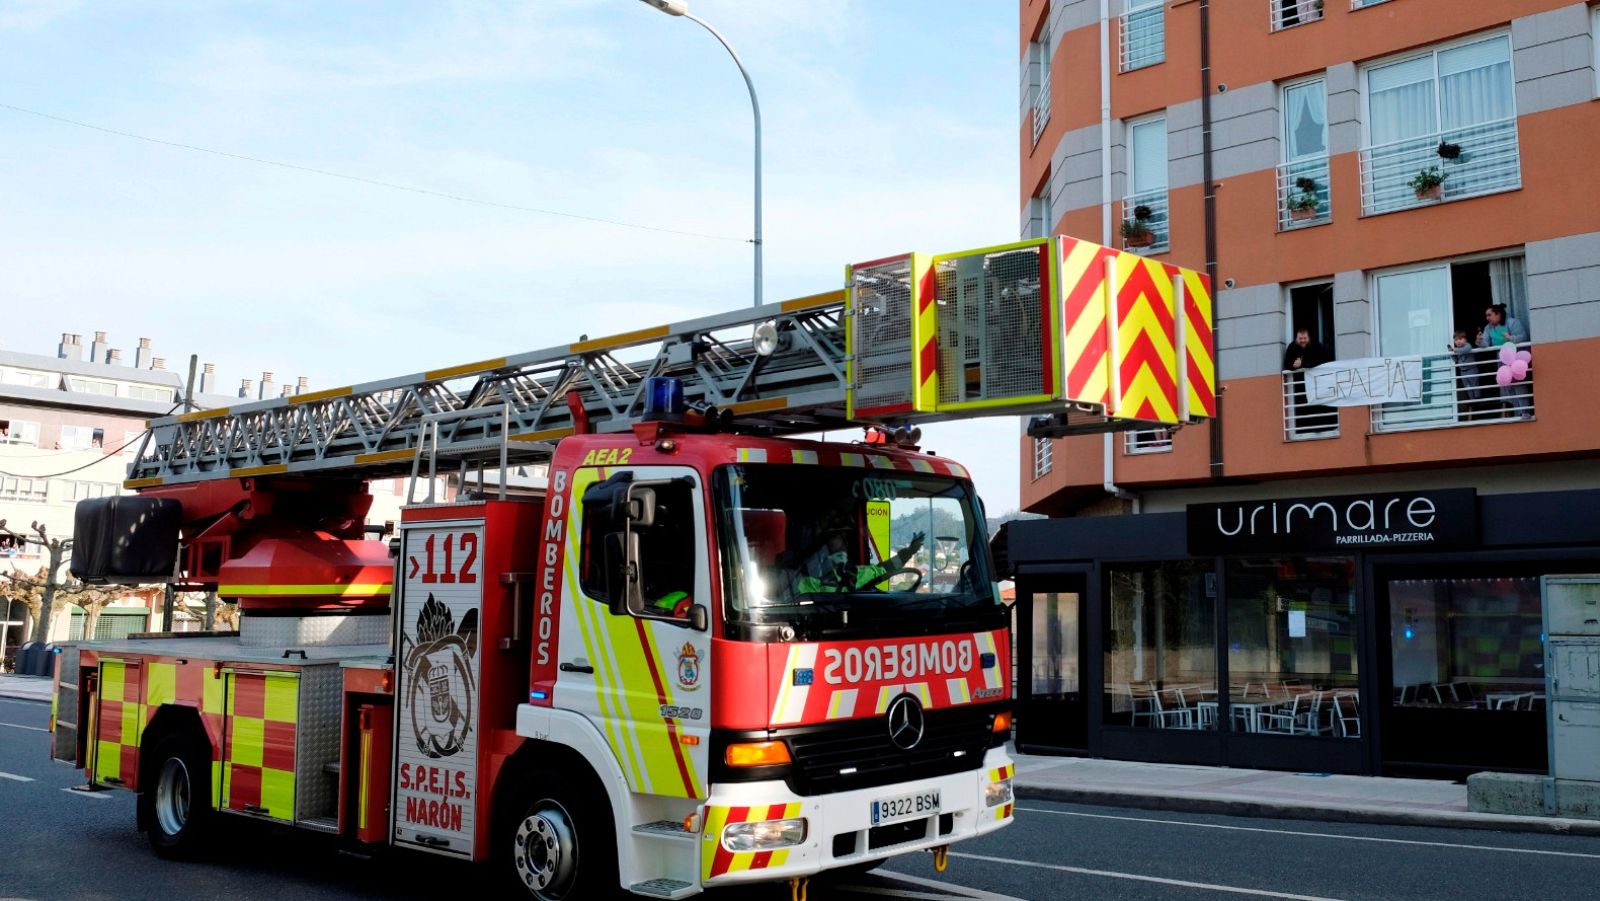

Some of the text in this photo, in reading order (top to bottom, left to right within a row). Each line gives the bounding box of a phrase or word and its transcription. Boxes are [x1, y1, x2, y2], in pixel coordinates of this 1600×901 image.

[1314, 358, 1422, 400] GRACIAS
[582, 447, 633, 465] AEA2
[1217, 497, 1436, 536] urimare
[1336, 532, 1435, 544] PARRILLADA-PIZZERIA
[537, 470, 567, 665] BOMBEROS
[659, 704, 703, 720] 1520
[400, 762, 471, 799] S.P.E.I.S.
[406, 796, 463, 831] NARÓN
[881, 793, 940, 818] 9322 BSM
